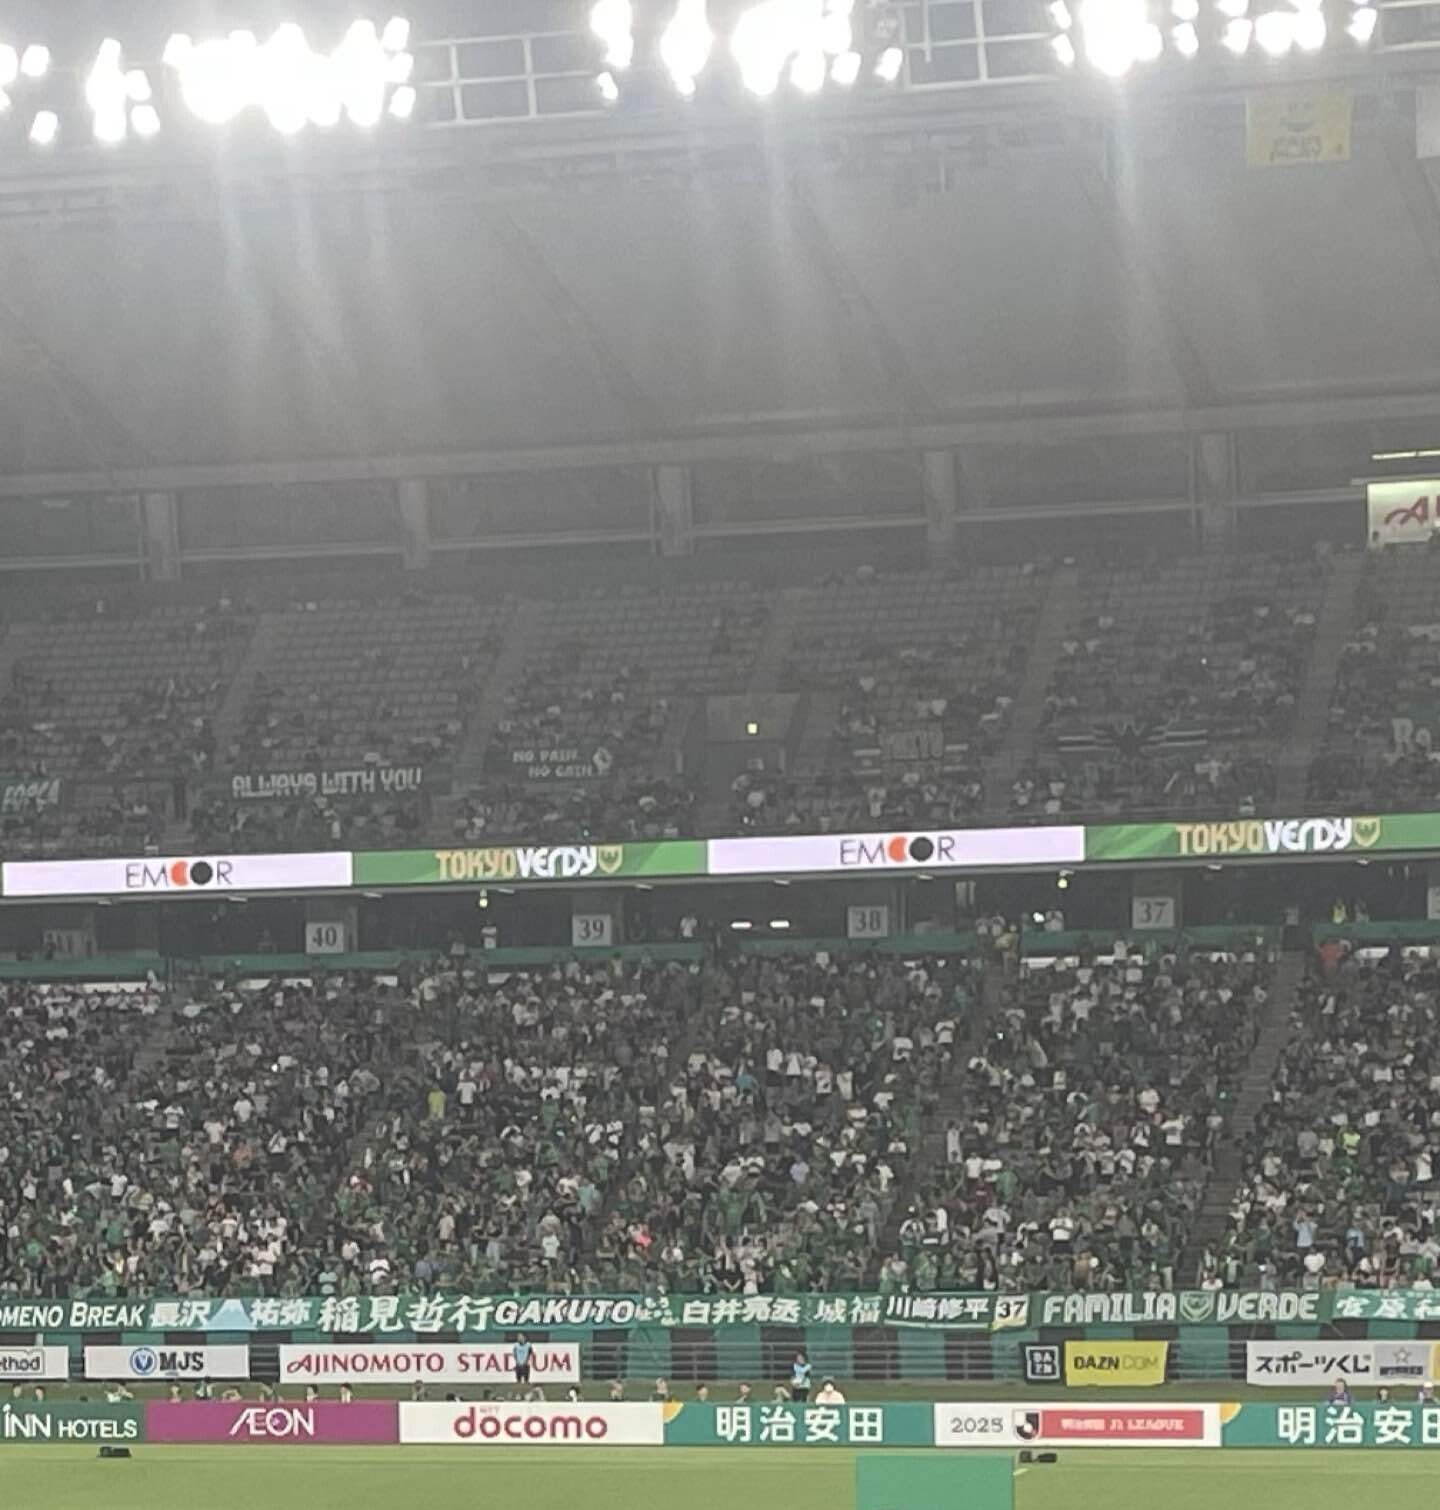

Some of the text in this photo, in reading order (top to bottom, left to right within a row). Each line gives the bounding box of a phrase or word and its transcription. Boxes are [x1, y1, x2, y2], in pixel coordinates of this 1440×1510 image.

[232, 767, 423, 798] ALWAYS WITH YOU
[853, 910, 882, 932] 38
[1138, 901, 1167, 924] 37
[311, 926, 337, 948] 40
[578, 918, 606, 940] 39
[70, 1303, 146, 1329] BREAK
[317, 1296, 494, 1333] 稲見哲行
[494, 1298, 637, 1326] GAKUTO
[997, 1300, 1026, 1319] 37
[1042, 1291, 1320, 1323] FAMILIA VERDE
[158, 1351, 204, 1371] MJS
[286, 1352, 572, 1376] AJINOMOTO STADUM
[1073, 1356, 1120, 1371] DAZN
[1255, 1351, 1371, 1374] スポーツくじ
[4, 1403, 52, 1440] INN
[58, 1418, 138, 1440] HOTELS
[453, 1406, 609, 1440] docomo
[715, 1405, 885, 1442] 明治安田
[950, 1416, 1004, 1434] 2025
